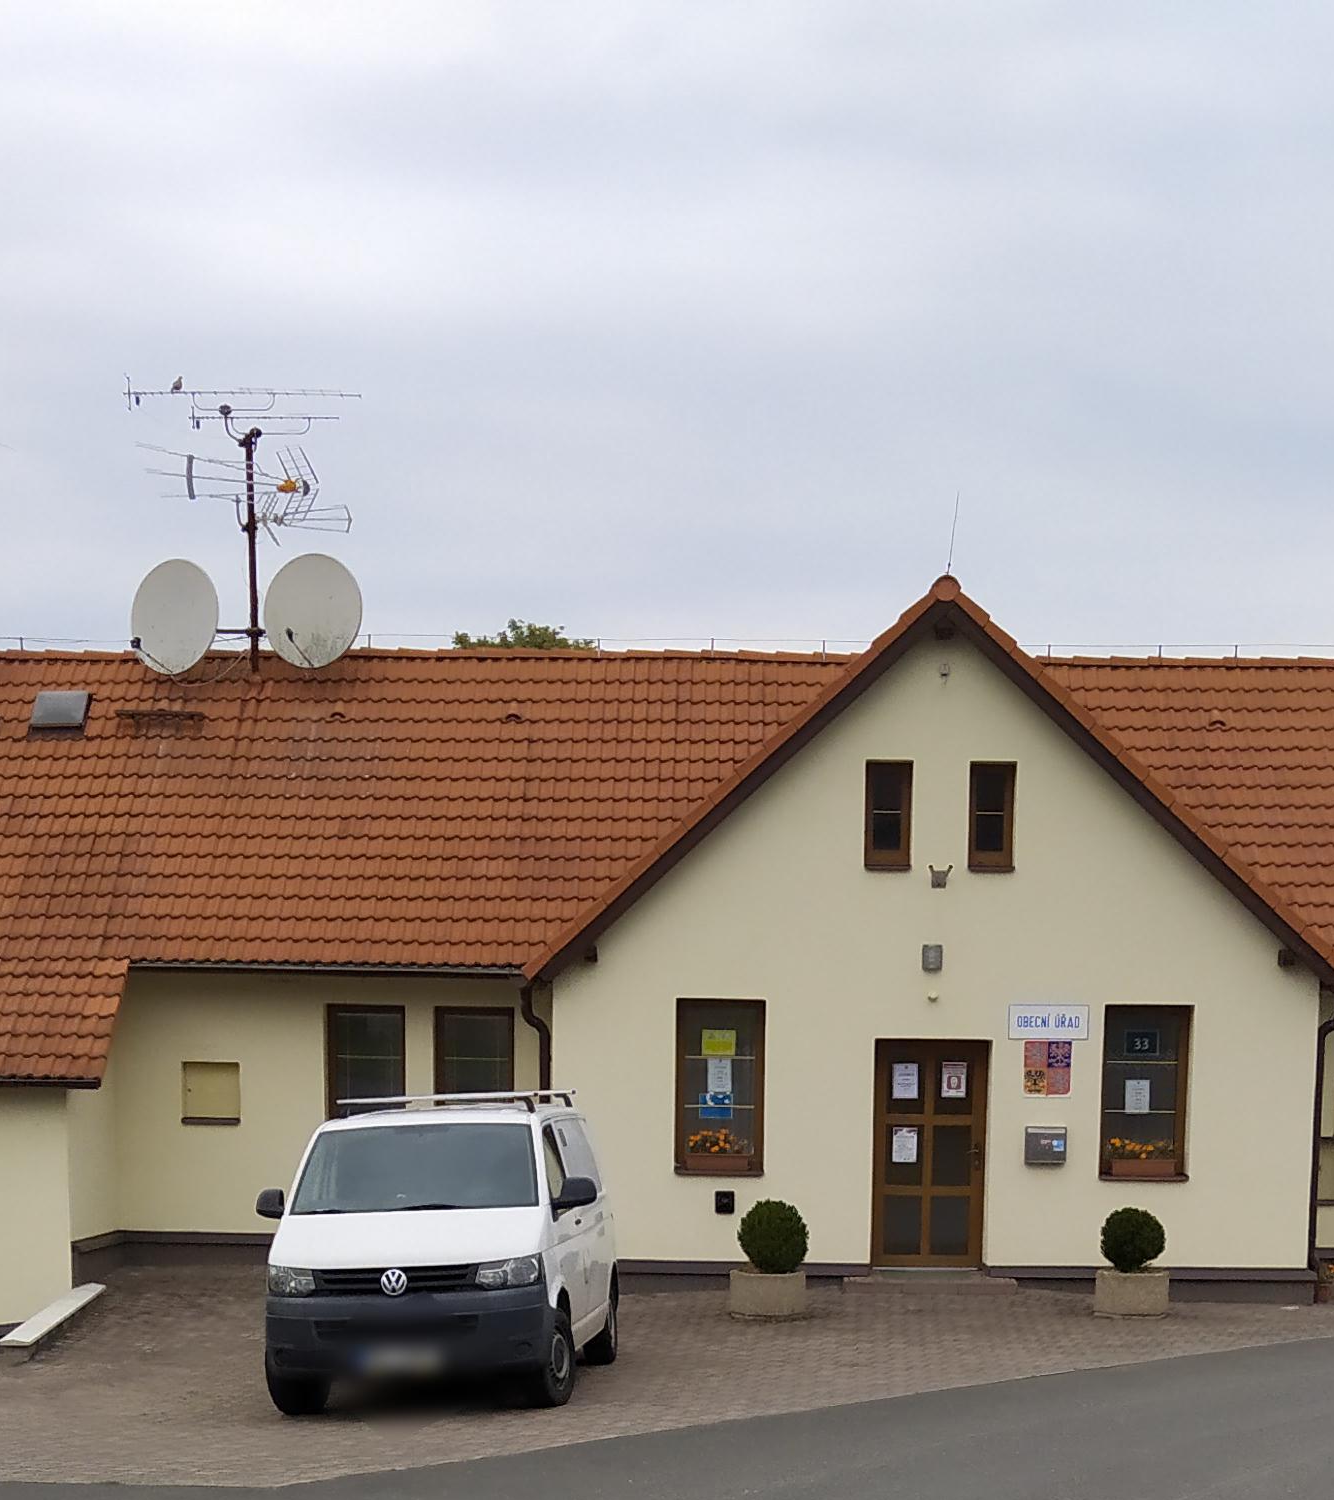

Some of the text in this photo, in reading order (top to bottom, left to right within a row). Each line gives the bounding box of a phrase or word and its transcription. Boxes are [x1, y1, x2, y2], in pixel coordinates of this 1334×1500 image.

[1017, 1013, 1080, 1028] OBECNÍ ÚŘAD
[1134, 1038, 1149, 1050] 33
